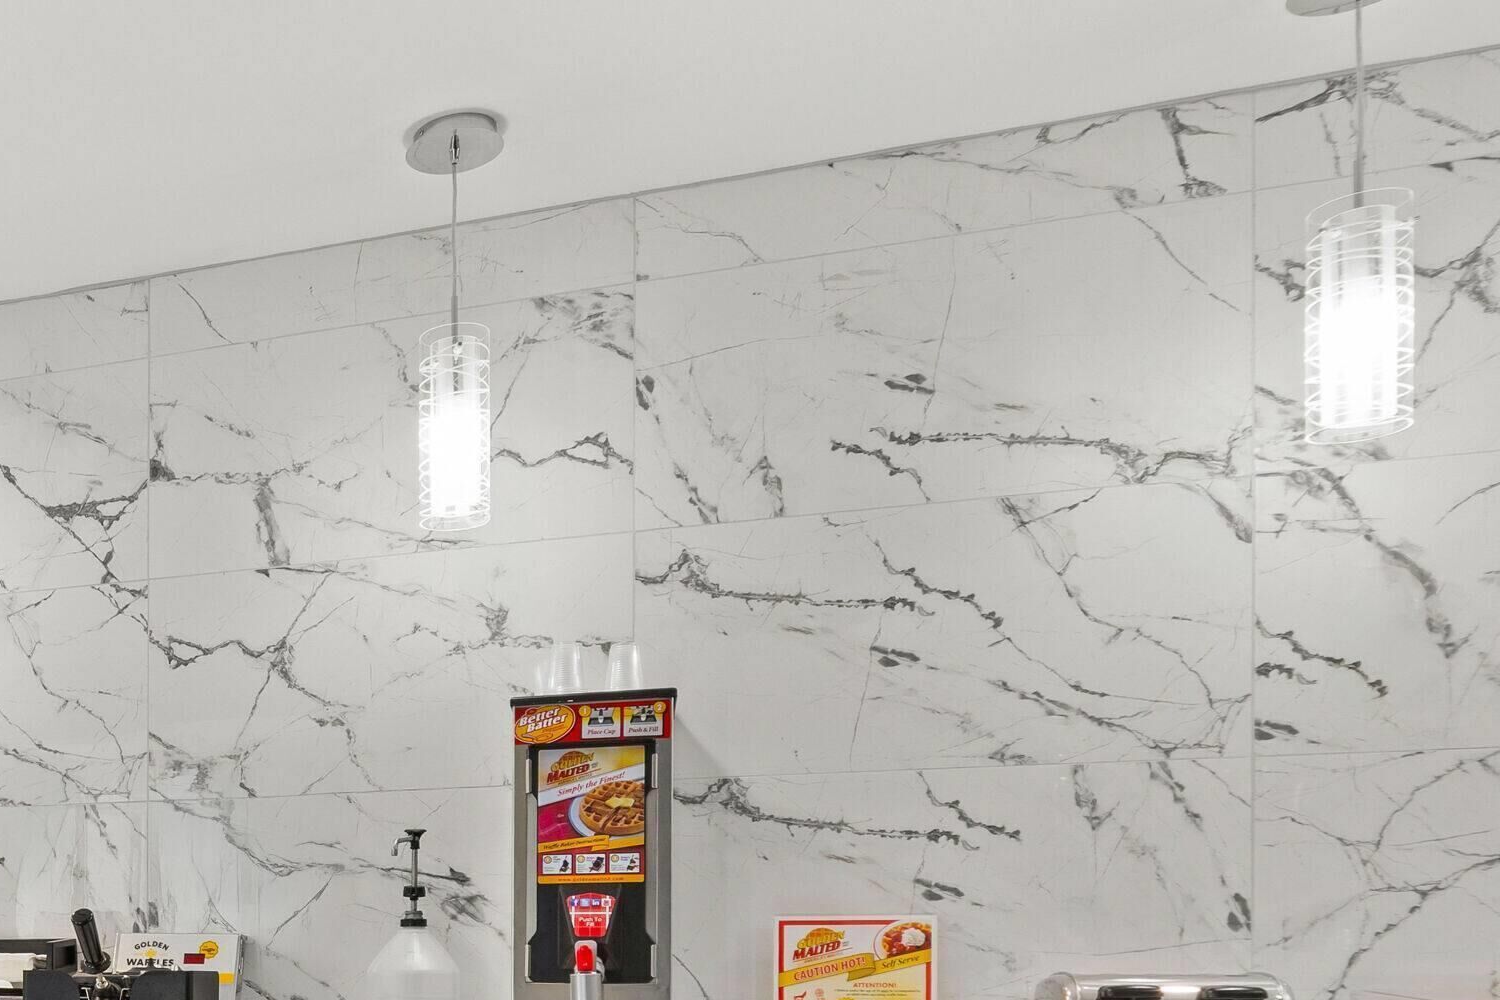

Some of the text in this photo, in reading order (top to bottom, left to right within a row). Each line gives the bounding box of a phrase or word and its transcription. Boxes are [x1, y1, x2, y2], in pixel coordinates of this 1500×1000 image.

[520, 707, 560, 726] Better
[527, 715, 567, 733] Batter
[547, 763, 590, 784] MALTED
[557, 784, 584, 796] Simply
[586, 779, 598, 788] the
[600, 771, 626, 784] Finest!
[134, 940, 170, 951] GOLDEN
[793, 940, 841, 961] MALTED
[793, 964, 839, 981] CAUTION
[841, 956, 866, 970] HOT!
[881, 955, 920, 970] Self Serve
